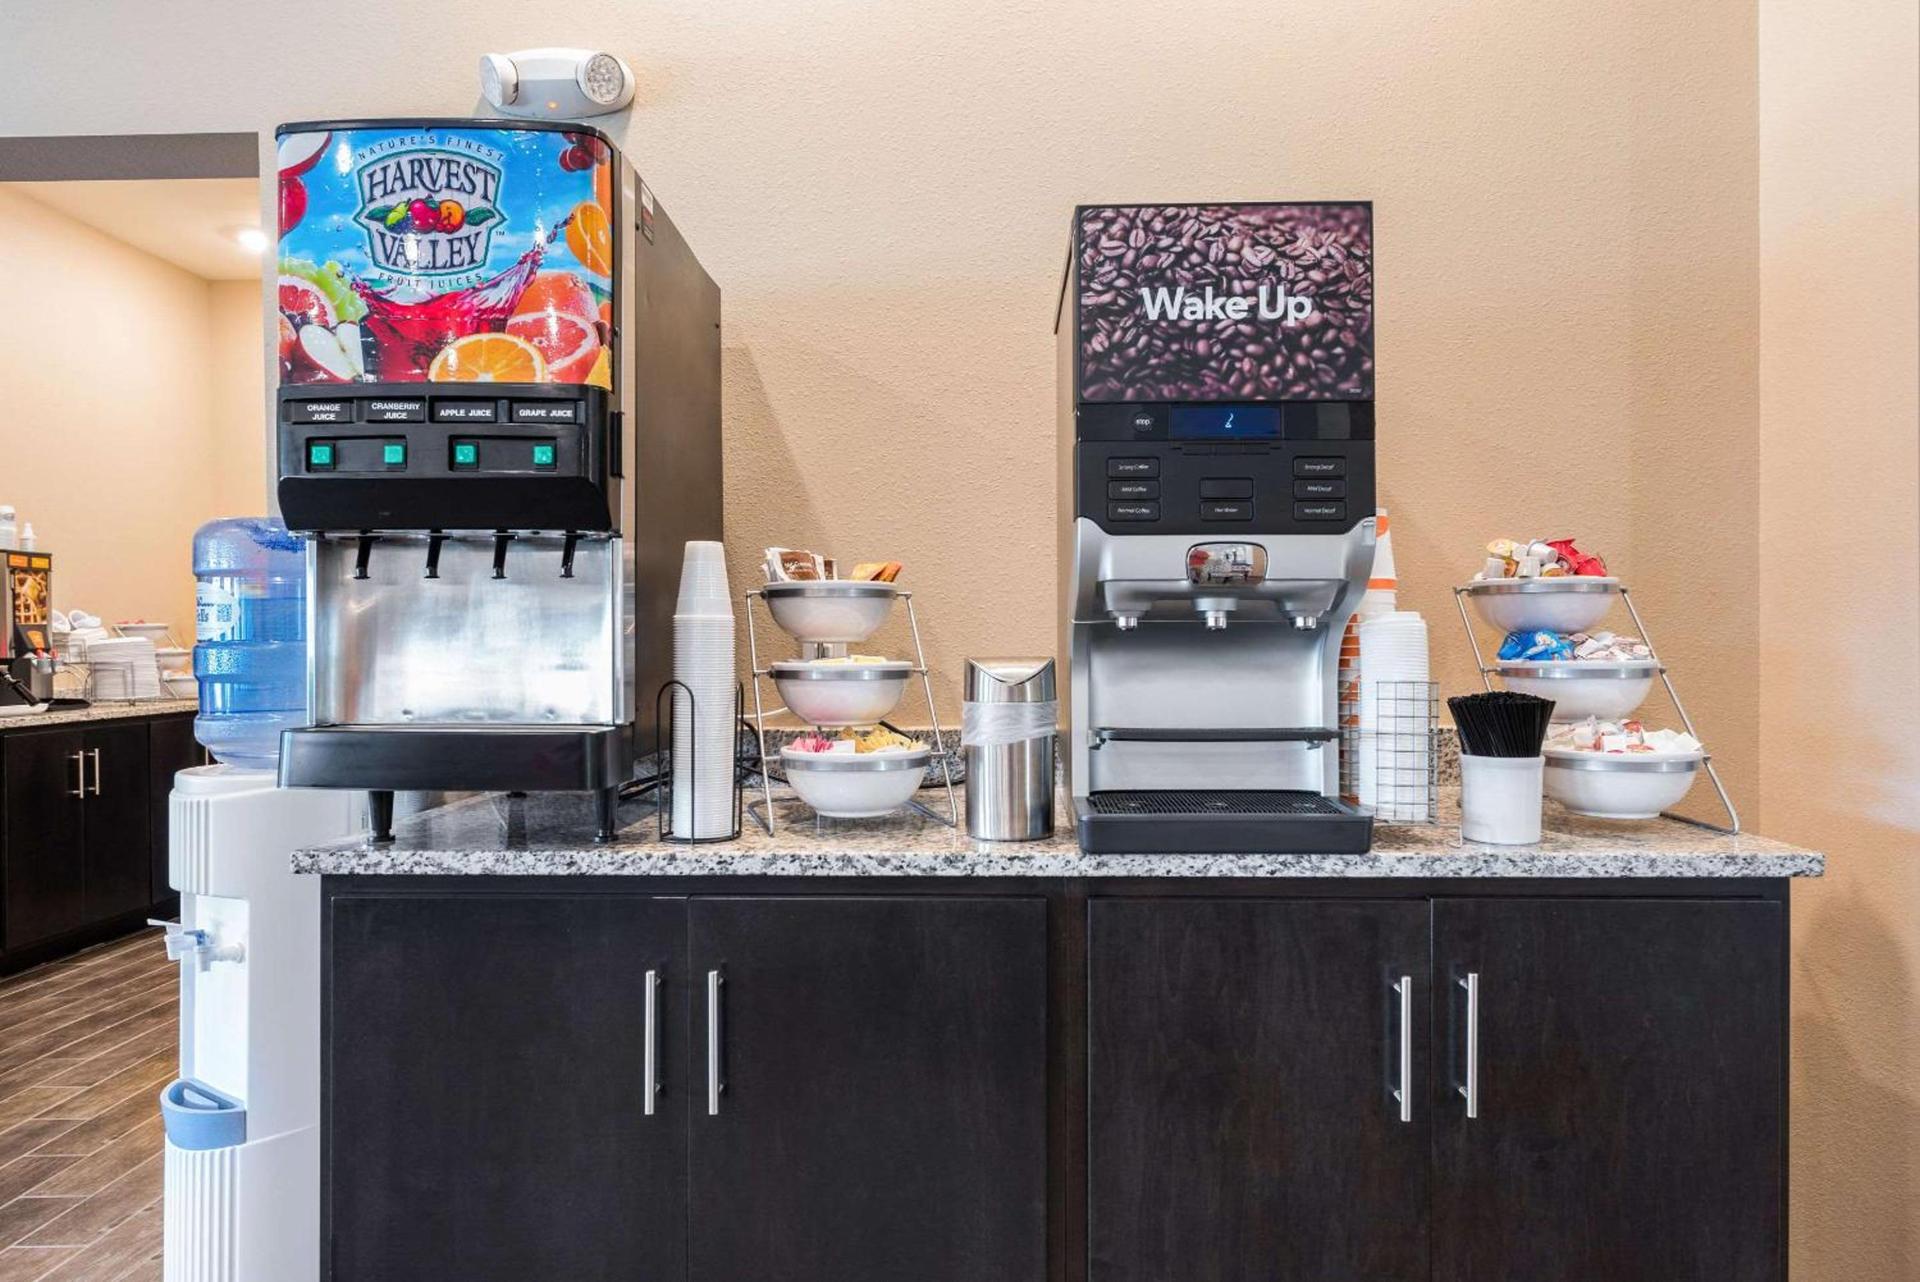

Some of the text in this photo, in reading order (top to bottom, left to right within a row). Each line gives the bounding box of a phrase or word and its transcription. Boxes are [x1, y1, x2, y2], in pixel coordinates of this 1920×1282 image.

[358, 136, 503, 161] NATURE'S FINEST
[366, 157, 496, 203] HARVEST
[376, 228, 482, 270] VALLEY
[378, 272, 482, 289] FRUIT JUICES
[1142, 285, 1312, 327] Wake Up
[307, 404, 341, 412] ORANGE
[371, 402, 420, 411] CRANBERRY
[312, 412, 336, 421] JUICE
[383, 411, 408, 420] JUICE
[440, 409, 492, 417] APPLE JUICE
[519, 409, 573, 418] GRAPE JUICE
